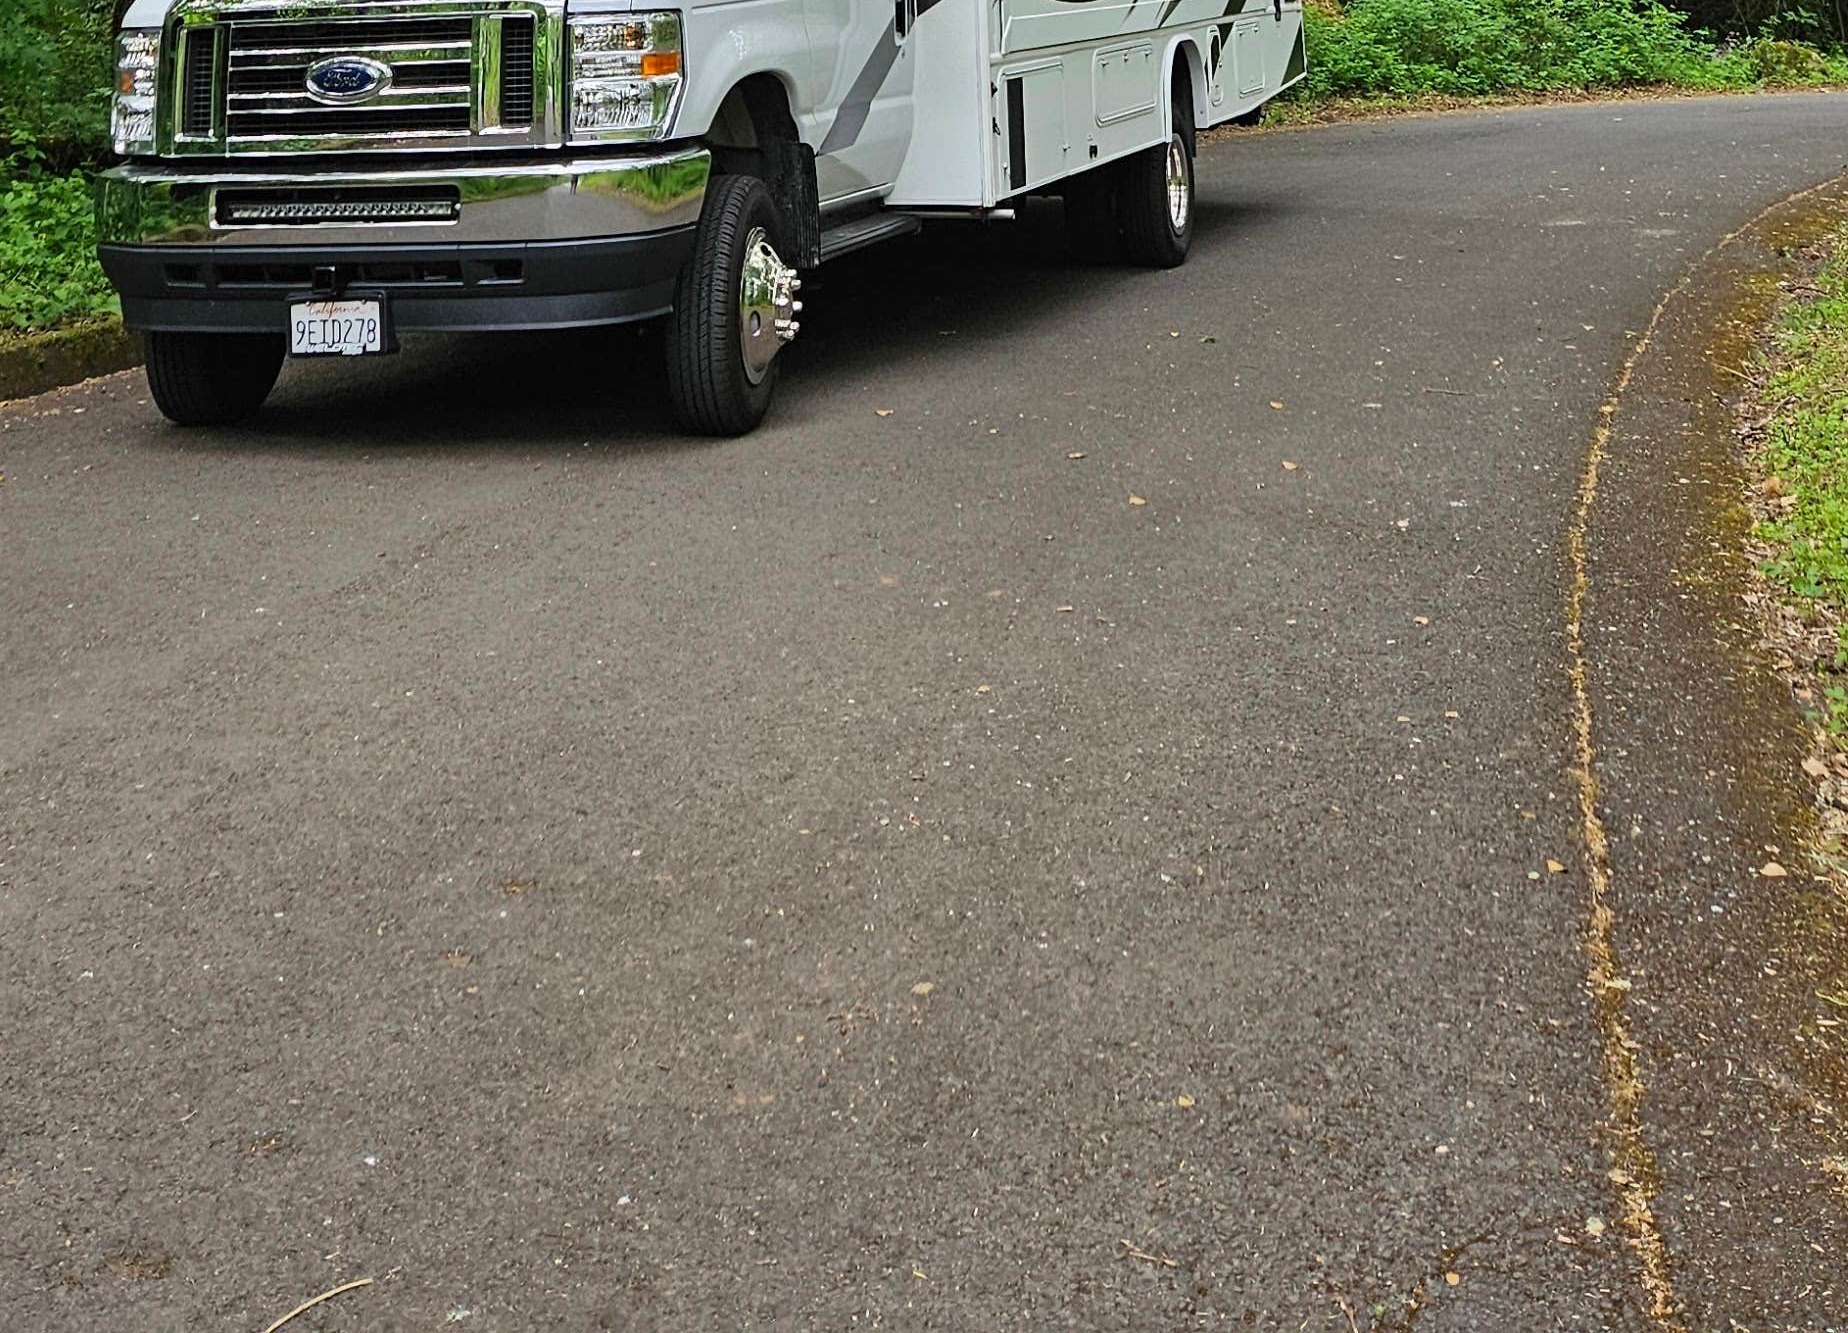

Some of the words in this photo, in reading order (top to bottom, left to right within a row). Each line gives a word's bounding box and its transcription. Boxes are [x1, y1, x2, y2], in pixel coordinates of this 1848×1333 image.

[323, 68, 361, 87] Ford
[308, 301, 361, 318] California
[296, 318, 377, 346] 9EID278
